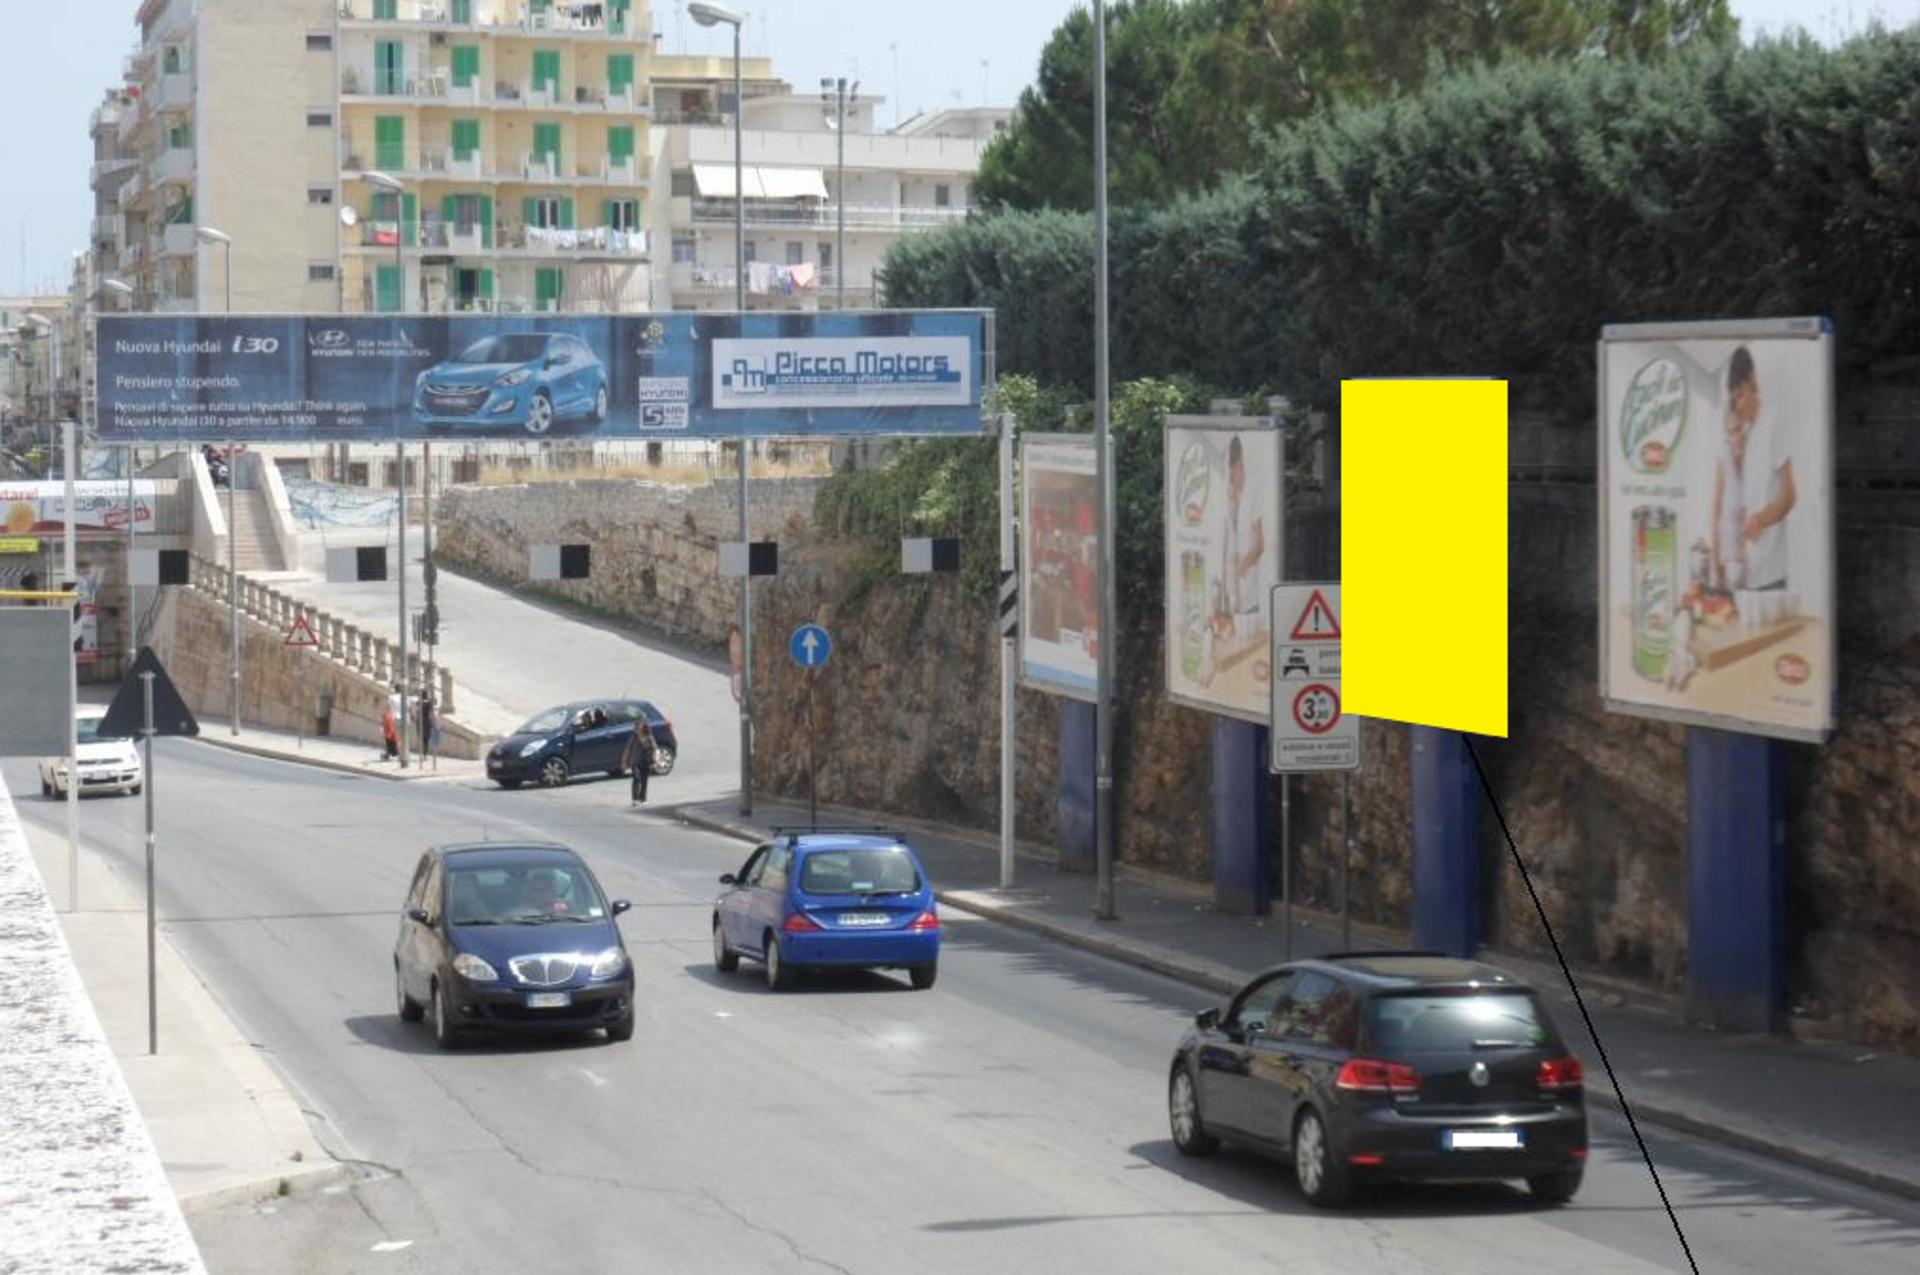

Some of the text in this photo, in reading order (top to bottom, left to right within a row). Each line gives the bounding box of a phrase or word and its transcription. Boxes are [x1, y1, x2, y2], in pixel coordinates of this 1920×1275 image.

[115, 335, 279, 356] Nuova Hyundai i30
[855, 351, 949, 374] Motors
[115, 374, 172, 389] Pensiero
[114, 415, 150, 426] Nuova
[152, 415, 198, 428] Hyundai
[1303, 697, 1316, 720] 3
